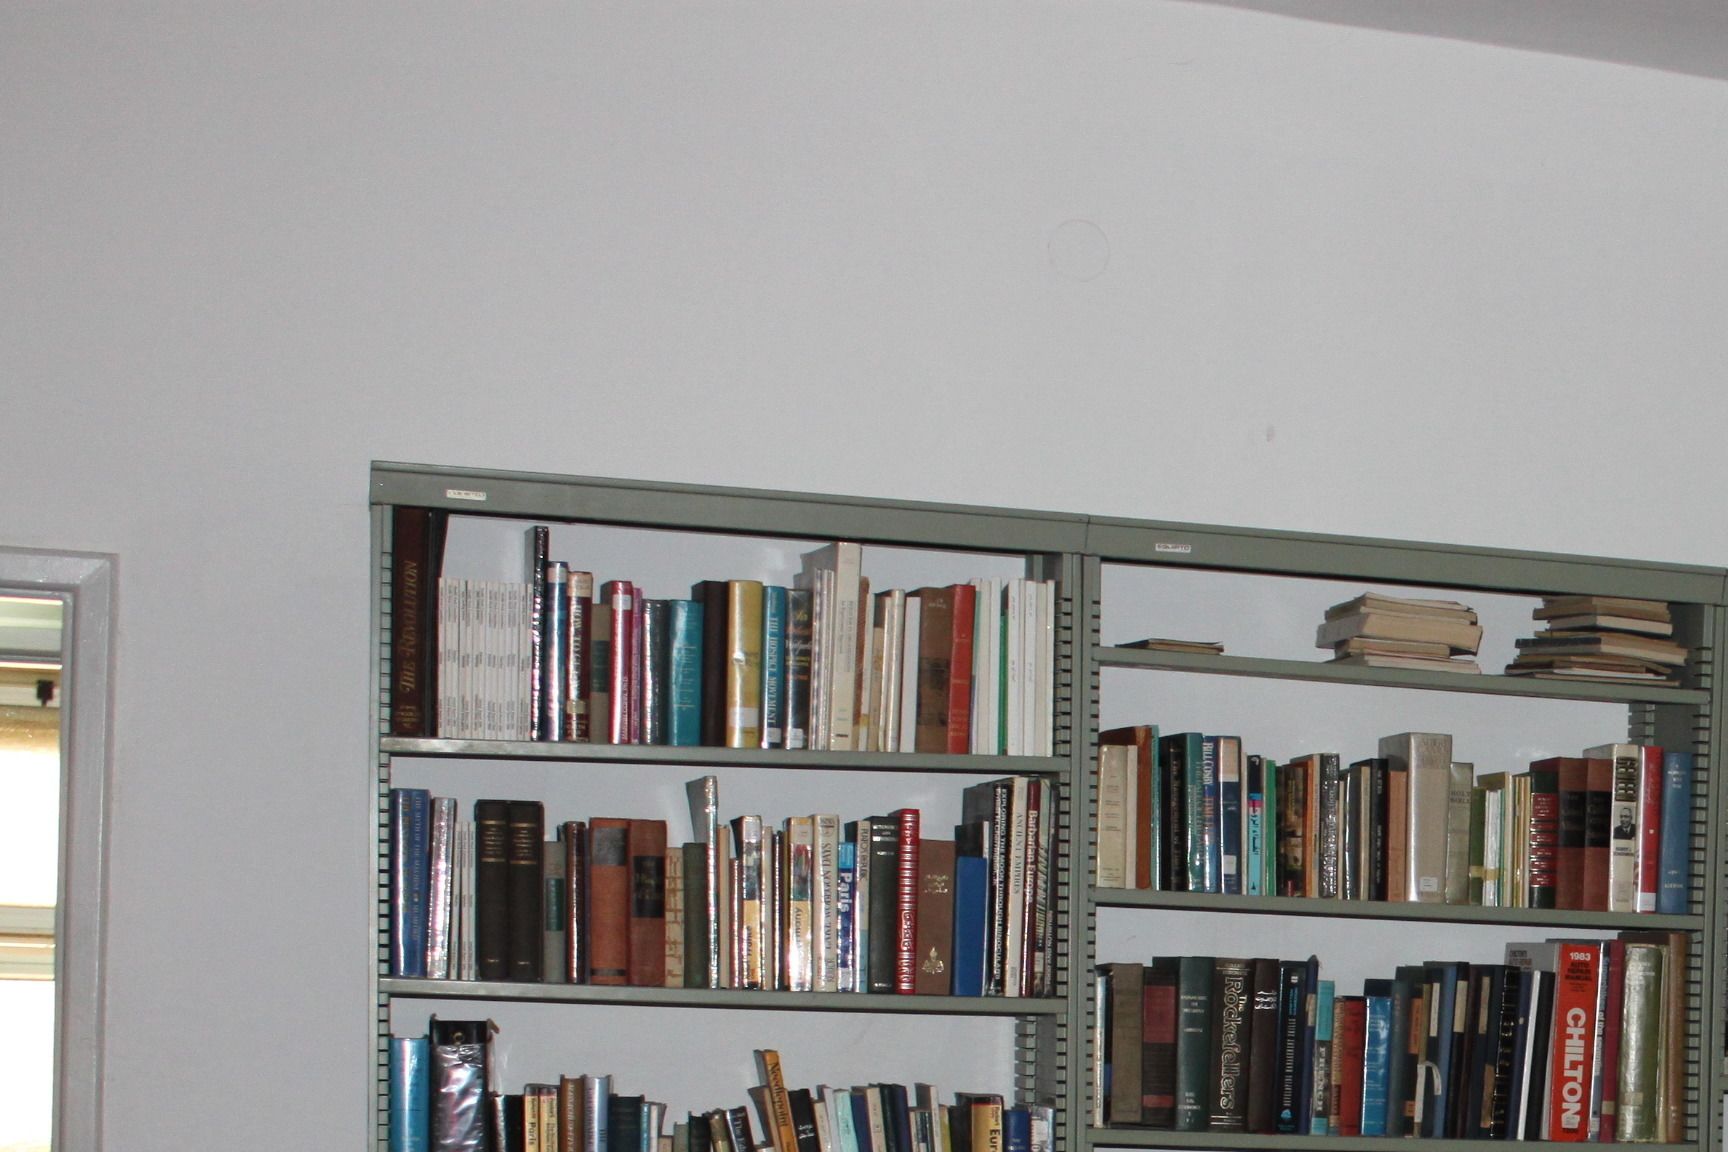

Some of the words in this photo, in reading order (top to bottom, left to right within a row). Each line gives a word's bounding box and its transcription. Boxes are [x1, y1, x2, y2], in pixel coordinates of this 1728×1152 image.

[767, 617, 778, 633] THE
[767, 638, 778, 671] HOSPICE
[766, 676, 777, 725] MOVEMENT
[841, 873, 853, 912] Paris
[1568, 952, 1592, 962] 1983
[1238, 994, 1247, 1011] The
[1221, 976, 1243, 1109] Rockefellers
[1561, 1008, 1587, 1127] CHILTON
[529, 1122, 538, 1146] Paris
